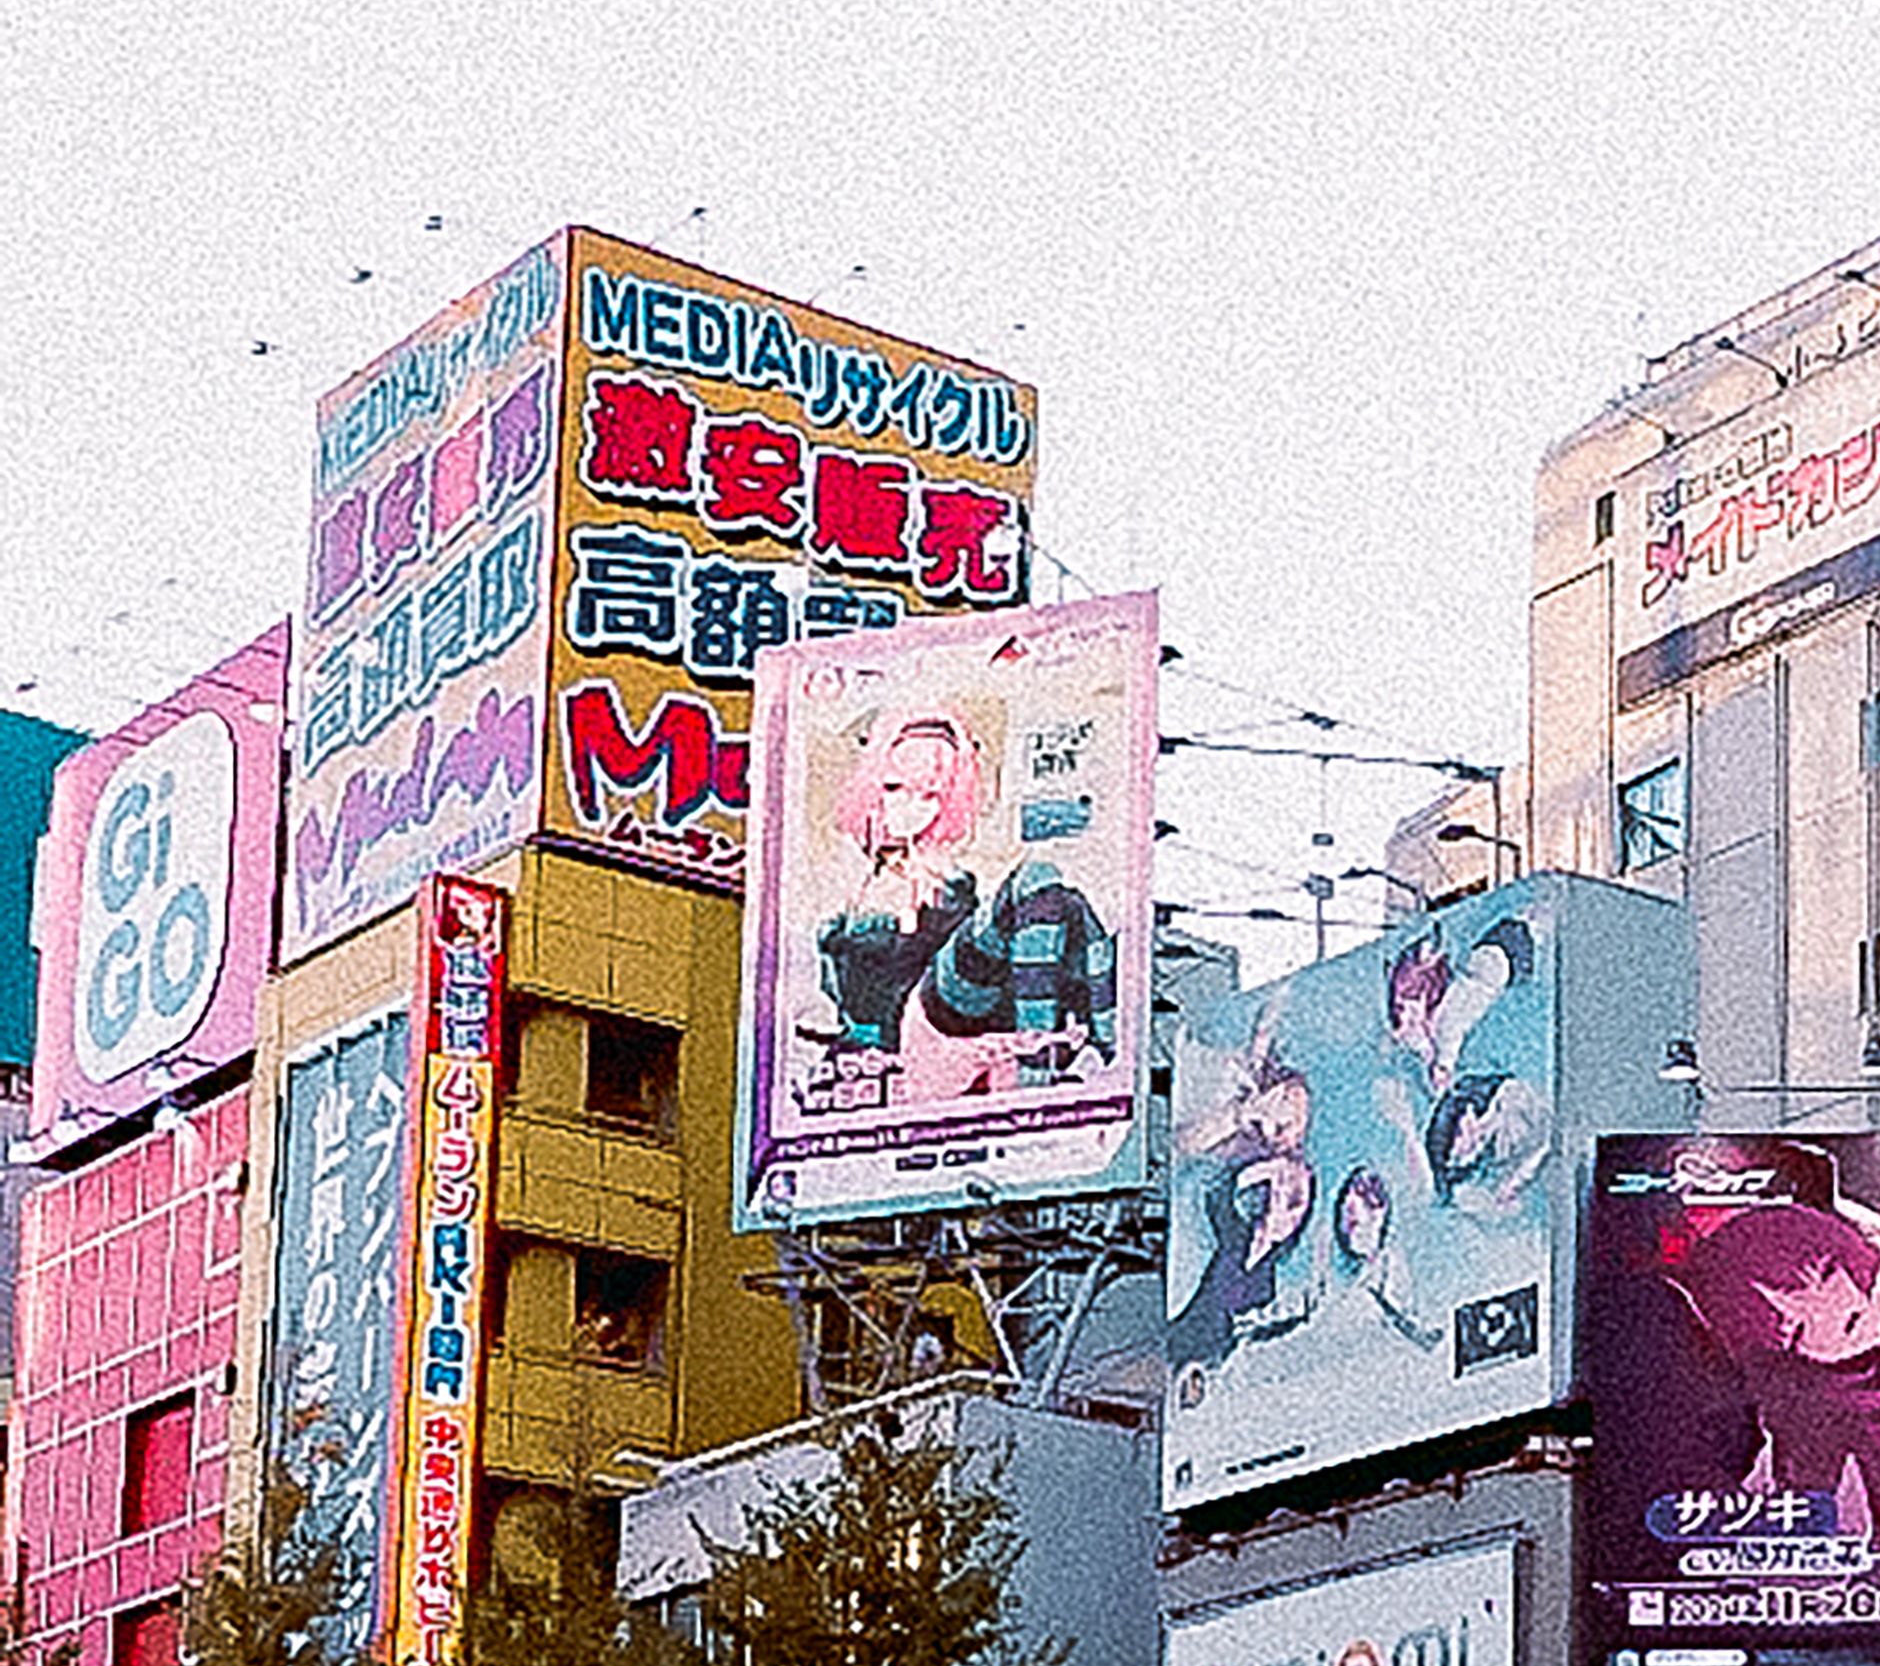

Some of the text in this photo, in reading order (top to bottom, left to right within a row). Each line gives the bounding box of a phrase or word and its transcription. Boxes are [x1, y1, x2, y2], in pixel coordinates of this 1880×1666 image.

[584, 268, 1032, 464] MEDIAリサイクル
[582, 370, 1018, 602] 激安販売
[96, 769, 178, 916] Gi
[86, 881, 210, 1054] GO
[1675, 1490, 1812, 1534] サツキ
